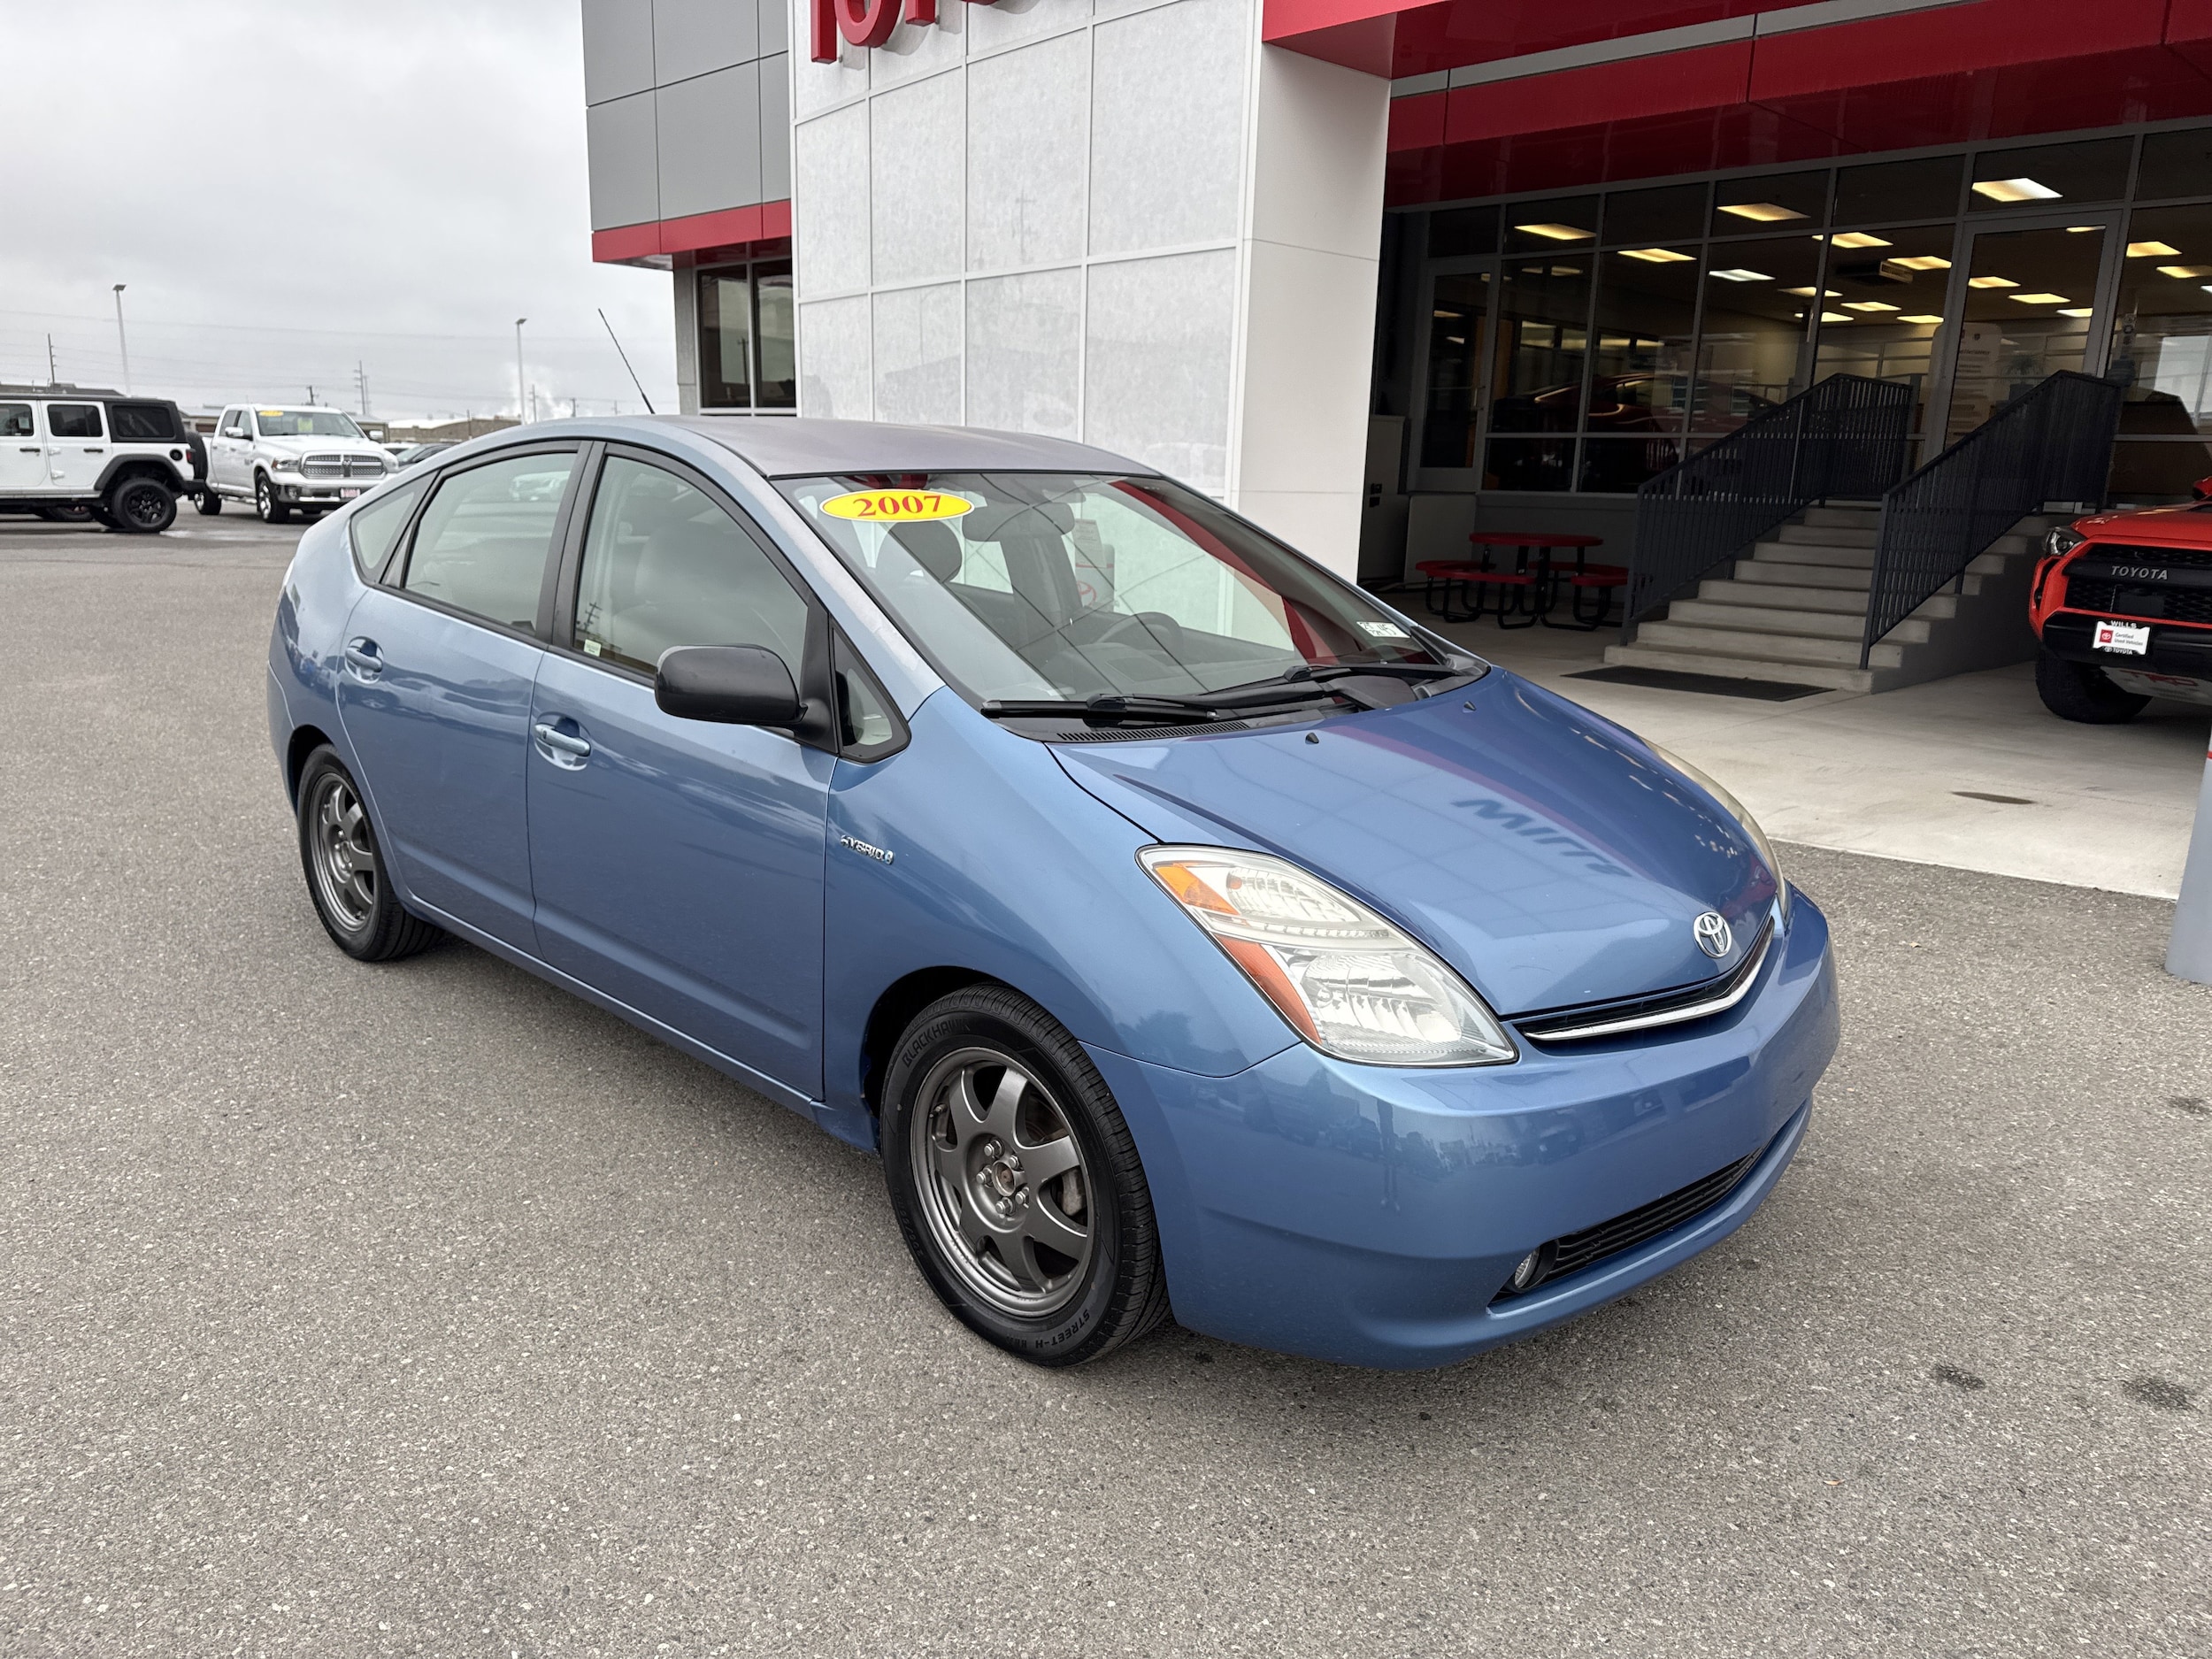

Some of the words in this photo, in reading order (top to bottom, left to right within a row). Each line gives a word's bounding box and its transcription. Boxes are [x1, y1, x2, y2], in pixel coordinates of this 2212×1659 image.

[853, 495, 941, 517] 2007
[2111, 565, 2168, 580] TOYOTA
[1034, 1310, 1090, 1348] STREET-H
